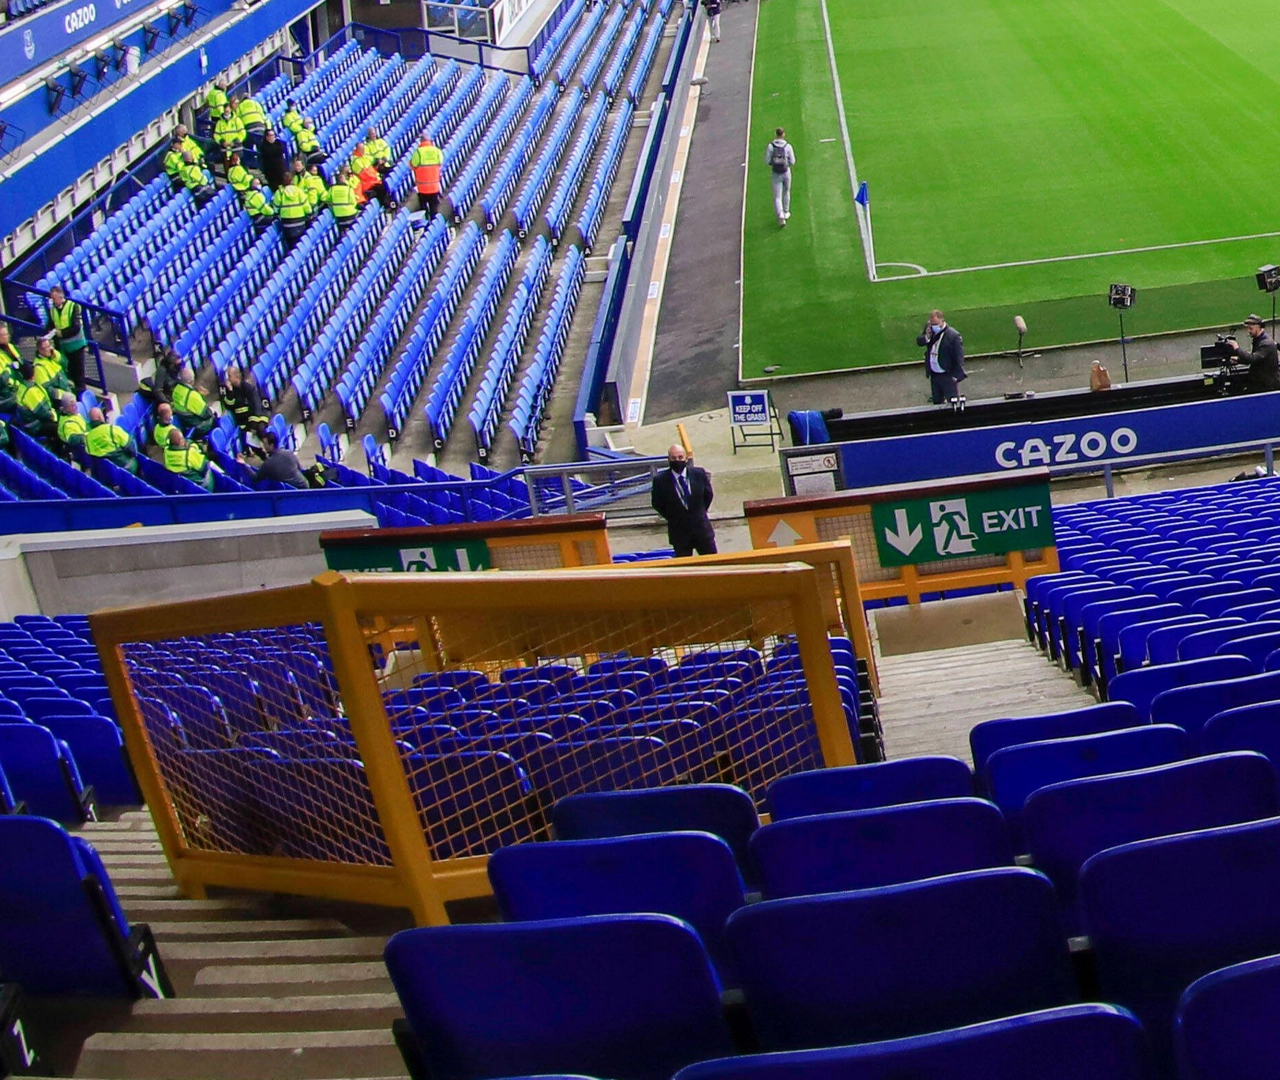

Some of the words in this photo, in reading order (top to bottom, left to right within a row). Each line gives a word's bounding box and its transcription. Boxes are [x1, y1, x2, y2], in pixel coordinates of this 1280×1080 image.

[65, 3, 96, 34] CAZOO
[735, 405, 750, 413] KEEP
[747, 413, 766, 421] GRASS
[995, 427, 1138, 468] CAZOO
[982, 505, 1043, 534] EXIT
